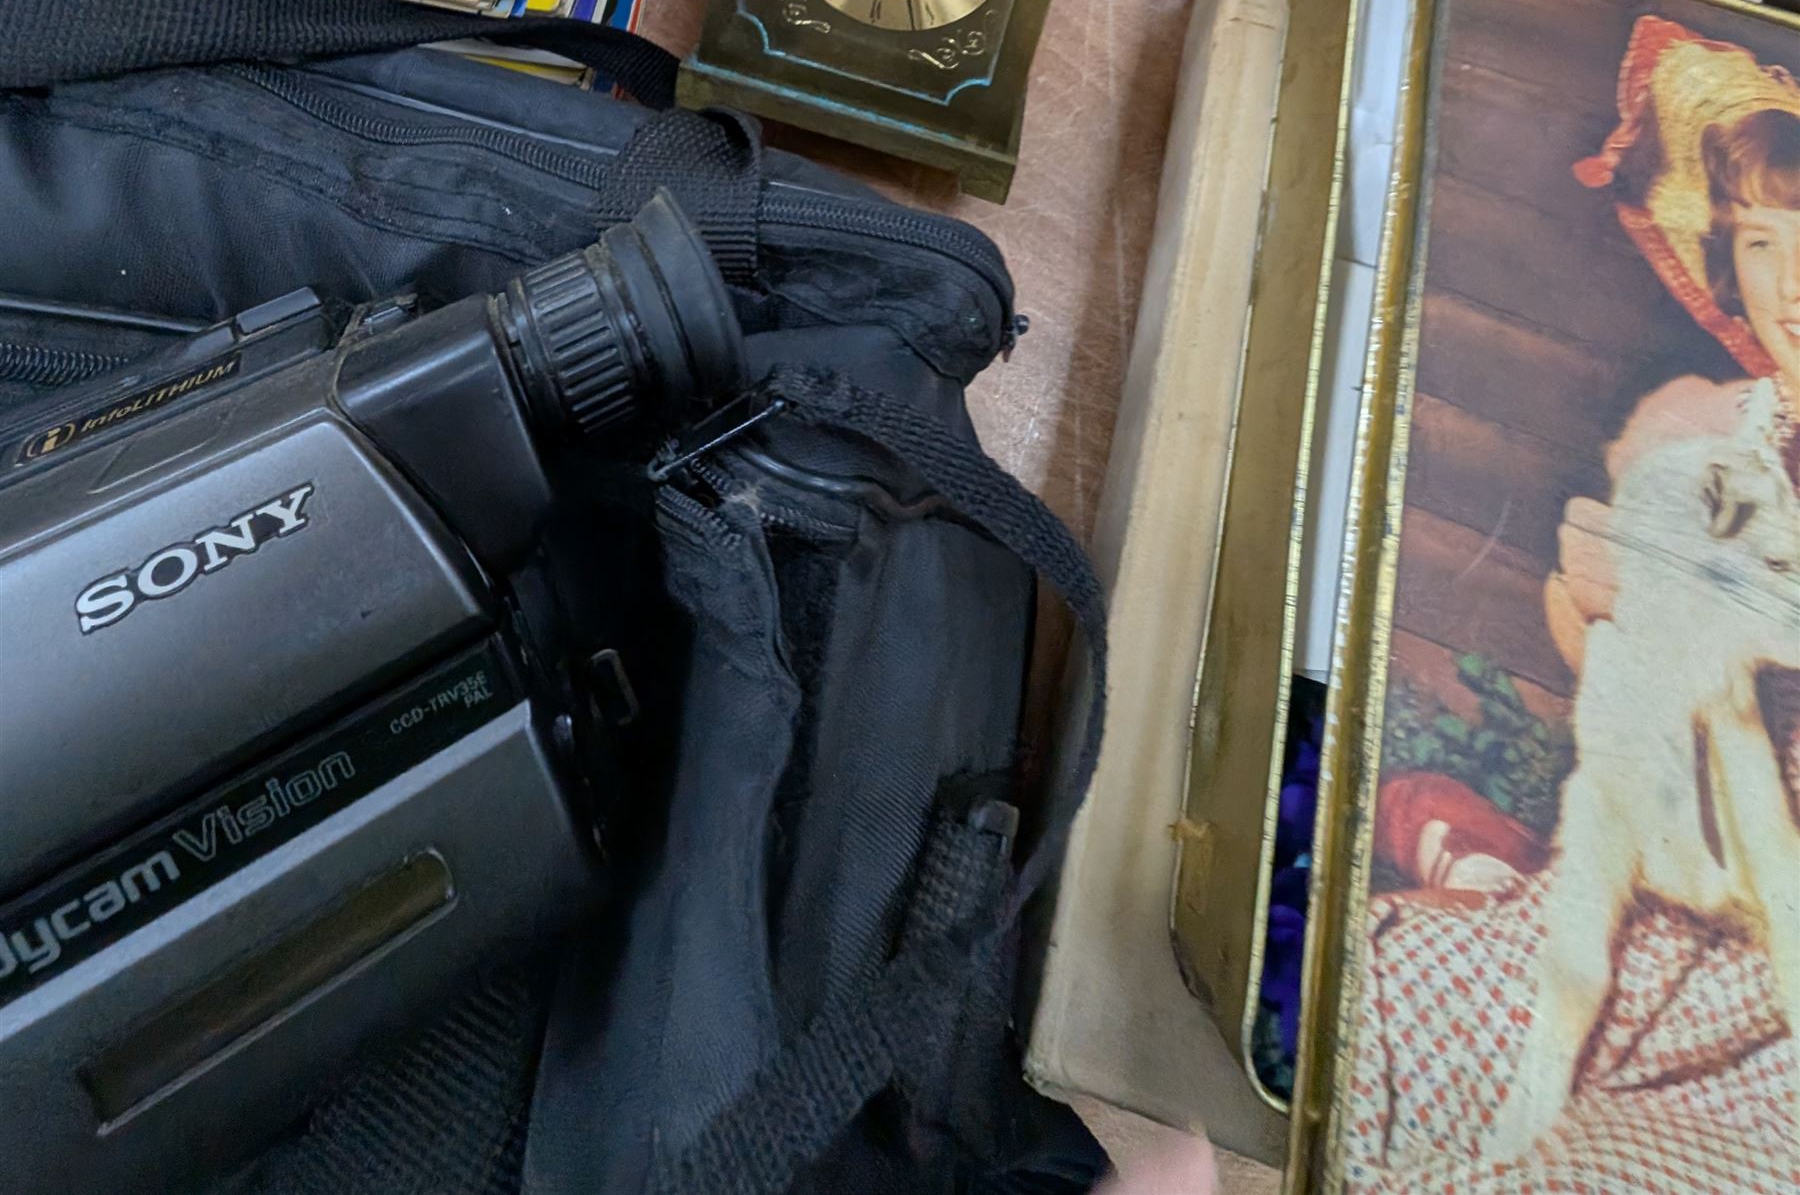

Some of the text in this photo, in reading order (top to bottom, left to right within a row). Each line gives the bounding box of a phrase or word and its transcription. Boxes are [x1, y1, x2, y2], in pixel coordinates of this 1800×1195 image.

[80, 360, 236, 433] InfoLITHIUM
[75, 485, 313, 635] SONY
[464, 684, 495, 710] PAL
[172, 750, 357, 862] Vision
